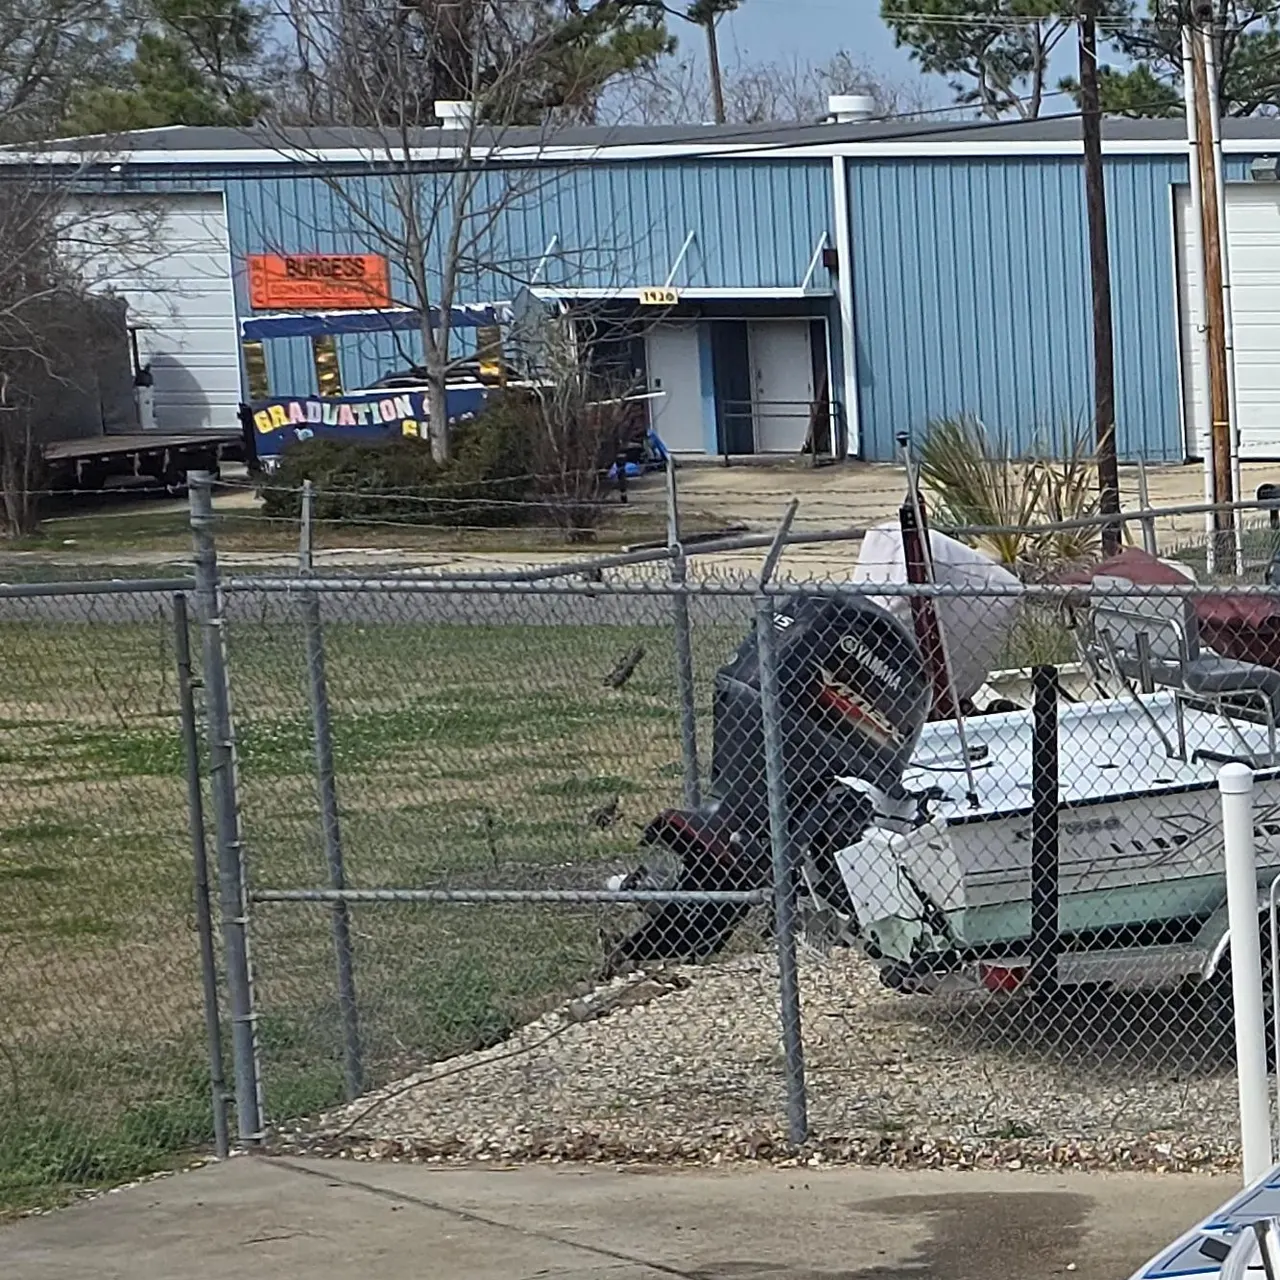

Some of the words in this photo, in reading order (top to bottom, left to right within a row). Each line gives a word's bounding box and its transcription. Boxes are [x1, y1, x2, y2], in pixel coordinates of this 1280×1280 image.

[286, 257, 365, 277] BURGESS
[254, 395, 413, 434] GRADUATION
[855, 644, 903, 690] YAMAHA
